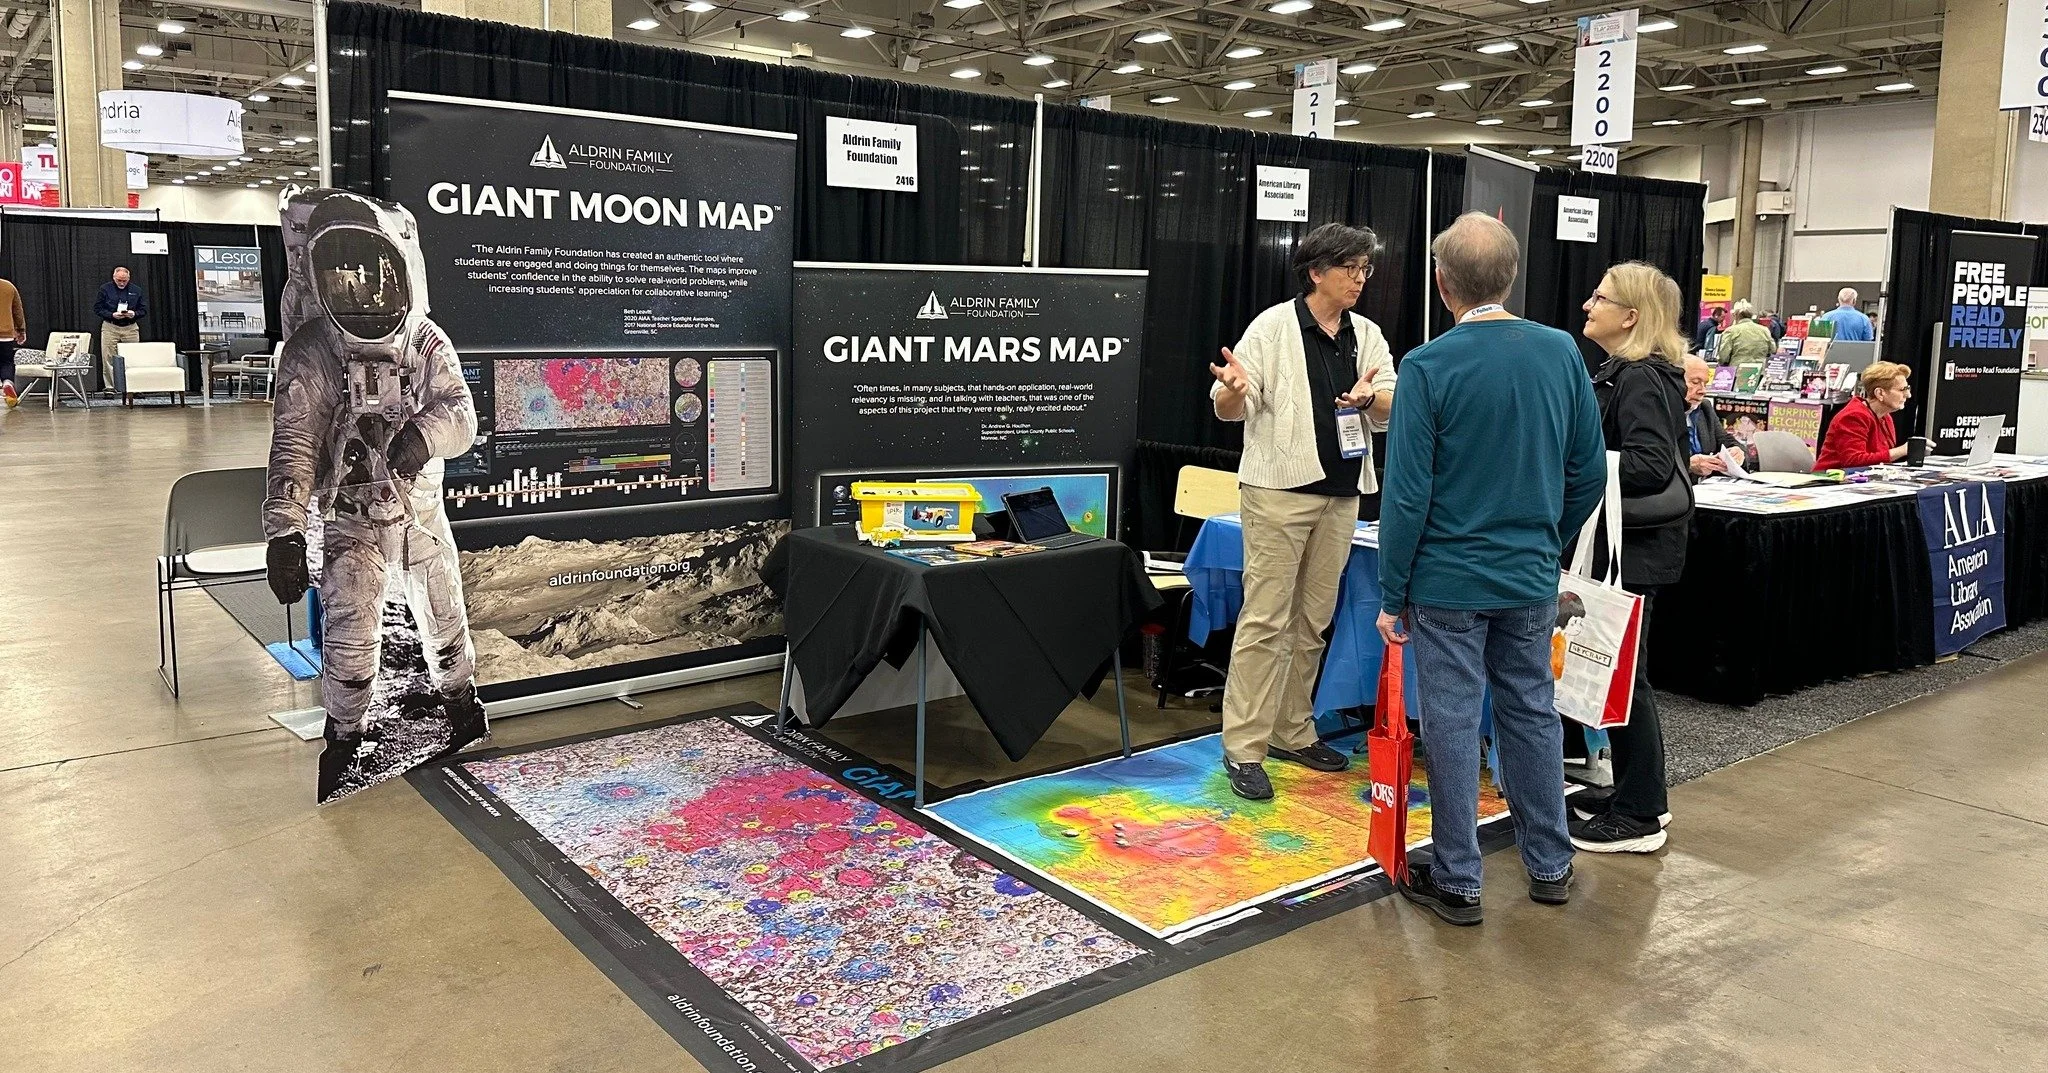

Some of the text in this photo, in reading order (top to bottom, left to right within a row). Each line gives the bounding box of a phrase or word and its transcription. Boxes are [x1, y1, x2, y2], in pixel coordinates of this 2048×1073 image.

[1595, 50, 1611, 137] 2200
[101, 101, 140, 119] ndria
[842, 133, 902, 151] Aldrin Family
[568, 144, 674, 165] ALDRIN FAMILY
[847, 150, 898, 165] Foundation
[1585, 150, 1614, 169] 2200
[589, 160, 655, 174] FOUNDATION
[896, 175, 915, 187] 2416
[1259, 179, 1302, 191] American Library
[428, 181, 560, 220] GIANT
[570, 191, 688, 227] MOON
[1264, 190, 1295, 200] Association
[215, 249, 259, 265] Lesro
[496, 245, 522, 255] Aldrin
[524, 246, 553, 258] Family
[554, 247, 604, 258] Foundation
[605, 250, 621, 259] has
[622, 251, 653, 260] created
[666, 252, 703, 262] authentic
[704, 254, 720, 262] tool
[720, 255, 744, 264] where
[454, 257, 758, 276] students are engaged and doing things themselves. The maps improve
[1954, 261, 2006, 285] FREE
[467, 271, 748, 287] students' confidence ability solve real-world problems, while
[488, 284, 534, 295] increasing
[536, 286, 576, 295] students'
[578, 287, 630, 296] appreciation
[644, 288, 695, 297] collaborative
[1952, 283, 2028, 307] PEOPLE
[950, 297, 1040, 310] ALDRIN FAMILY
[966, 309, 1024, 319] FOUNDATION
[1950, 305, 2005, 327] READ
[1948, 327, 2023, 349] FREELY
[823, 335, 935, 363] GIANT
[943, 336, 1041, 363] MARS
[463, 368, 481, 376] ANT
[1955, 366, 1976, 374] Freedom
[1995, 366, 2020, 374] Foundation
[879, 384, 902, 393] times,
[912, 385, 933, 393] many
[934, 384, 966, 393] subjects,
[983, 383, 1017, 392] hands-on
[1017, 383, 1057, 393] application,
[1058, 383, 1093, 391] real-world
[851, 395, 888, 405] relevancy
[897, 395, 928, 404] missing,
[929, 395, 944, 403] and
[953, 395, 977, 403] talking
[978, 394, 994, 402] with
[995, 394, 1028, 402] teachers,
[859, 407, 888, 415] aspects
[899, 406, 912, 414] this
[913, 406, 940, 415] project
[956, 405, 973, 414] they
[974, 405, 992, 413] were
[993, 404, 1015, 414] really,
[1016, 404, 1035, 413] really
[1036, 404, 1061, 412] excited
[1773, 406, 1819, 419] BURPING
[1768, 416, 1820, 430] BELCHING
[1940, 427, 1964, 439] FIRST
[1943, 483, 1997, 550] ALA
[1948, 548, 1988, 579] American
[549, 561, 691, 587] aldrinfoundation.org
[1950, 580, 1979, 607] Library
[1950, 596, 1993, 635] Association
[807, 740, 853, 762] FAMILY
